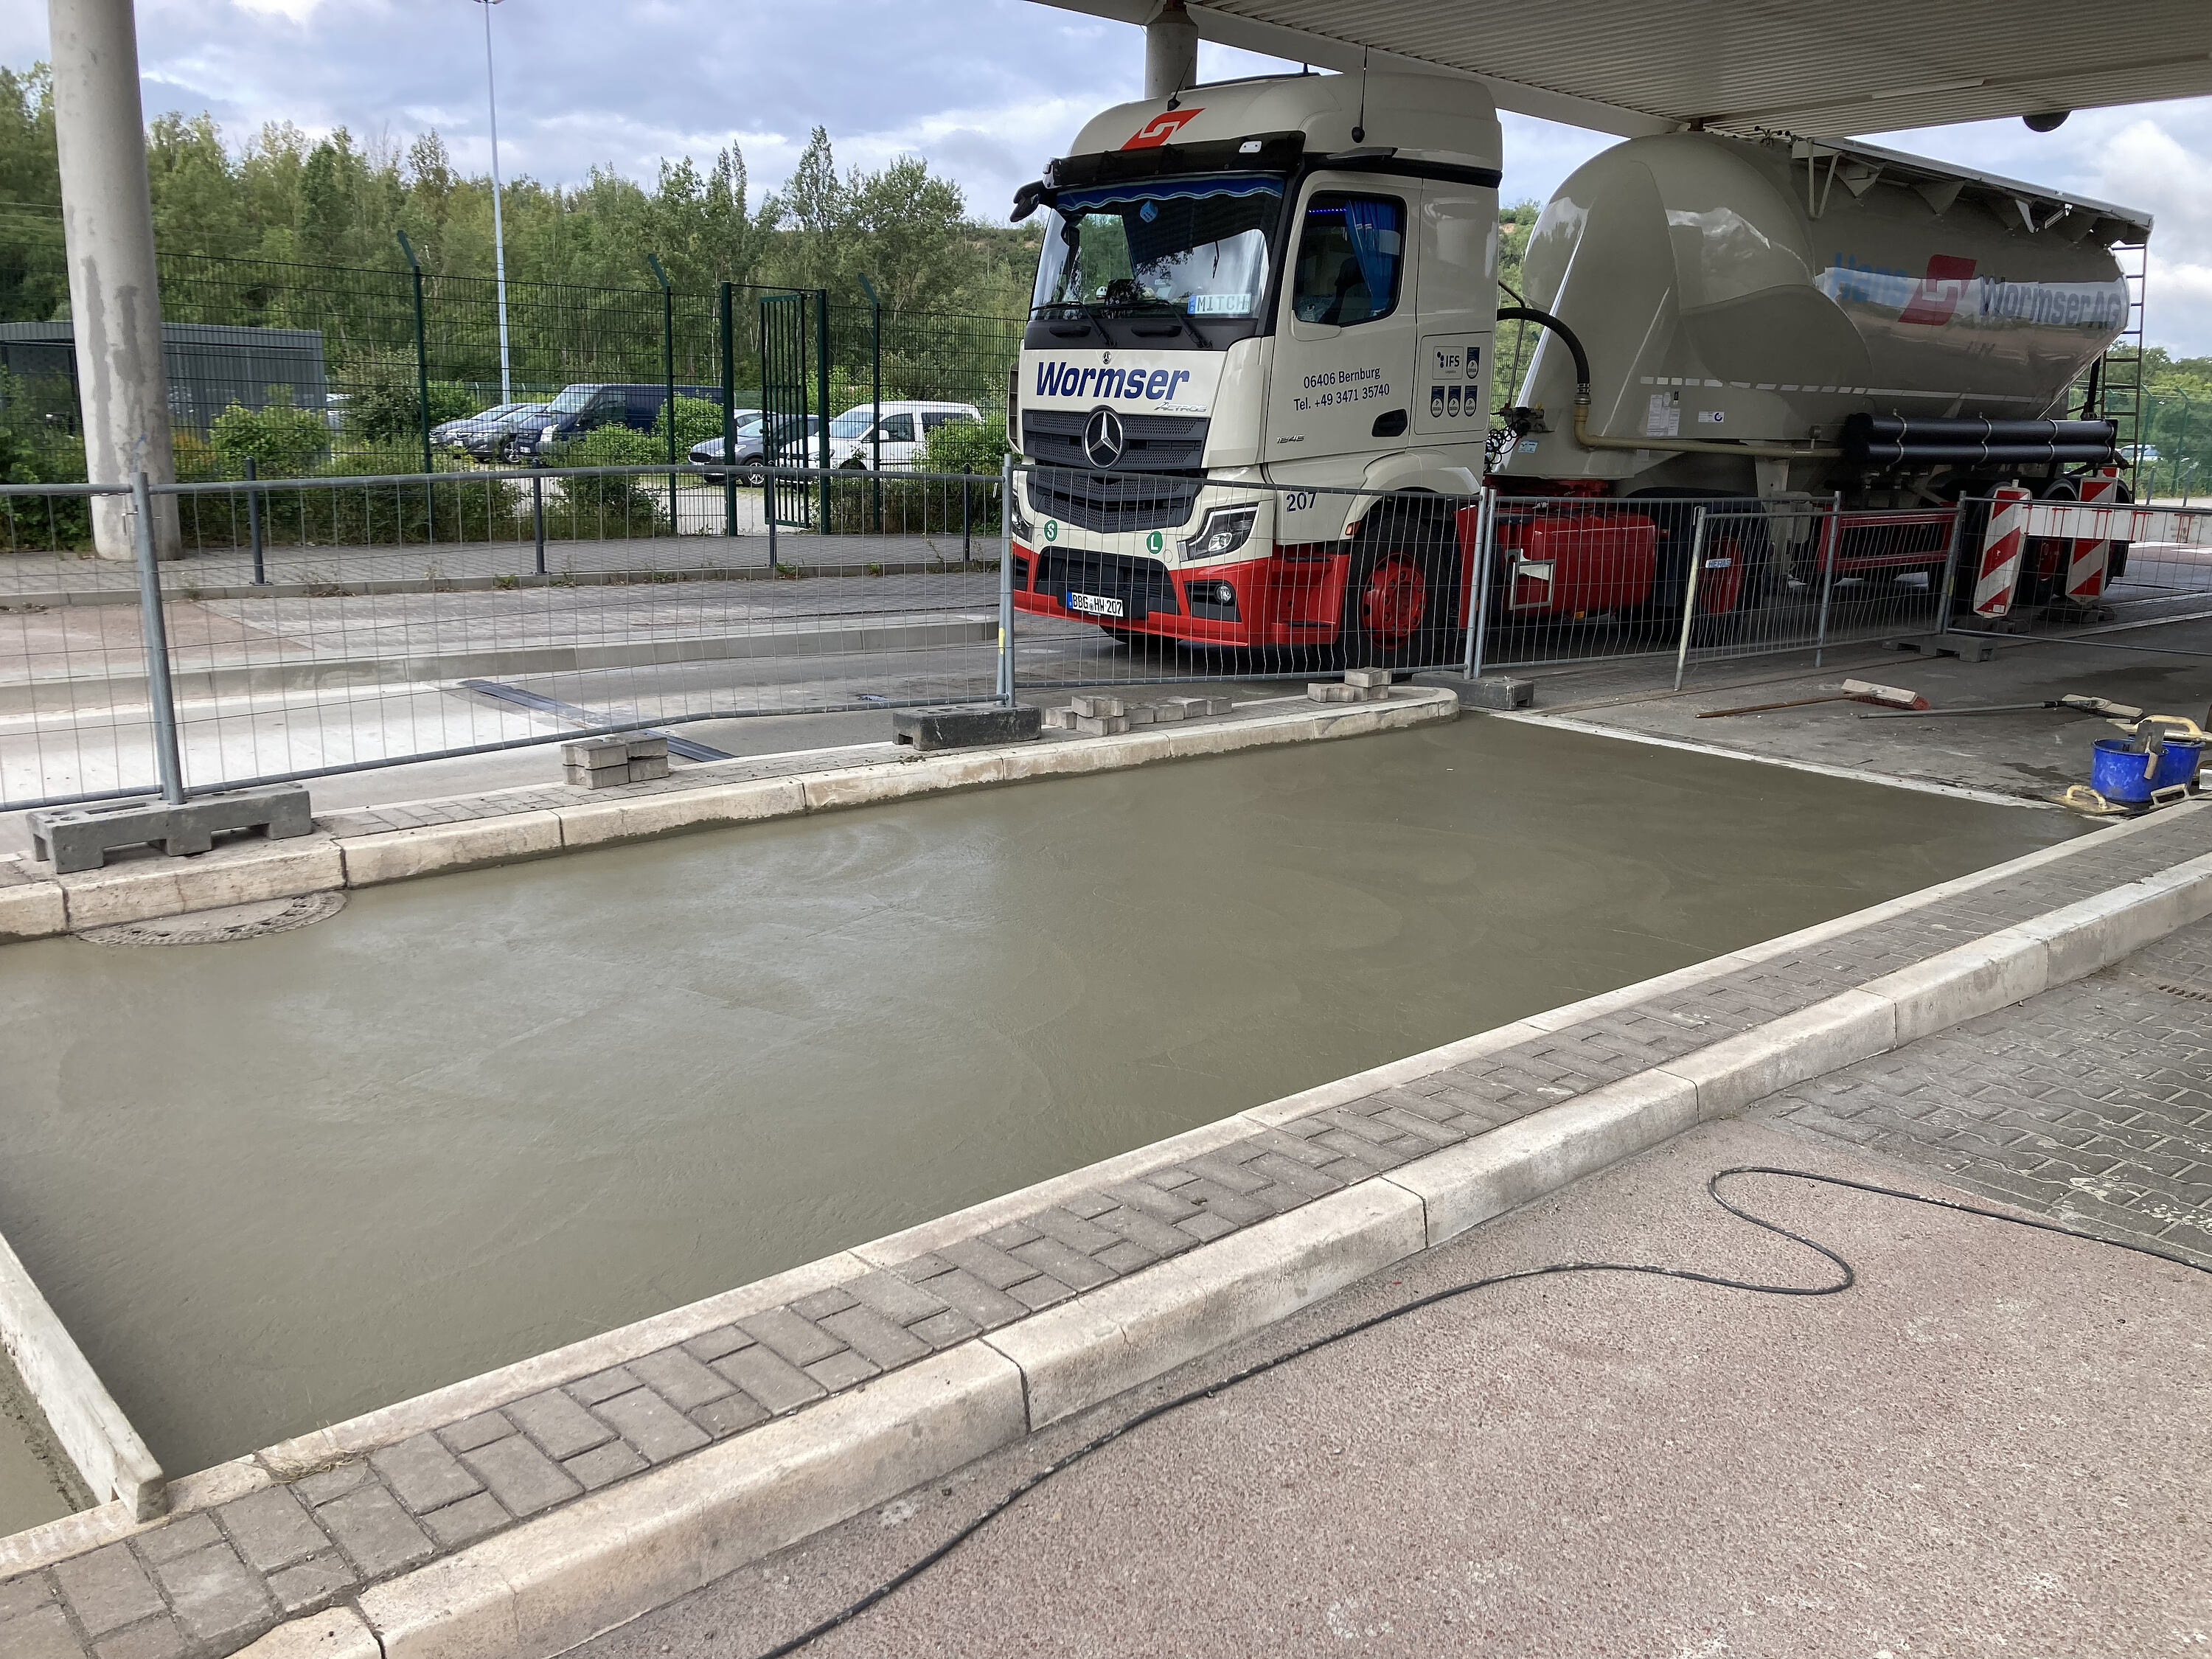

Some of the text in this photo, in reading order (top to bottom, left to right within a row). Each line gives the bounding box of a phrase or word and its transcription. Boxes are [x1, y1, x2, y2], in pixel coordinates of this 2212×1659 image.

[1197, 296, 1246, 311] MITCH
[1979, 274, 2122, 330] Wormser AG
[1446, 355, 1460, 367] IFS
[1036, 361, 1190, 400] Wormser
[1304, 368, 1381, 389] 06406 Bernburg
[1294, 383, 1390, 411] Tel. +49 3471 35740
[1286, 492, 1317, 512] 207
[1047, 523, 1054, 538] S
[1150, 535, 1159, 550] L
[1073, 594, 1122, 615] BBG HW 207
